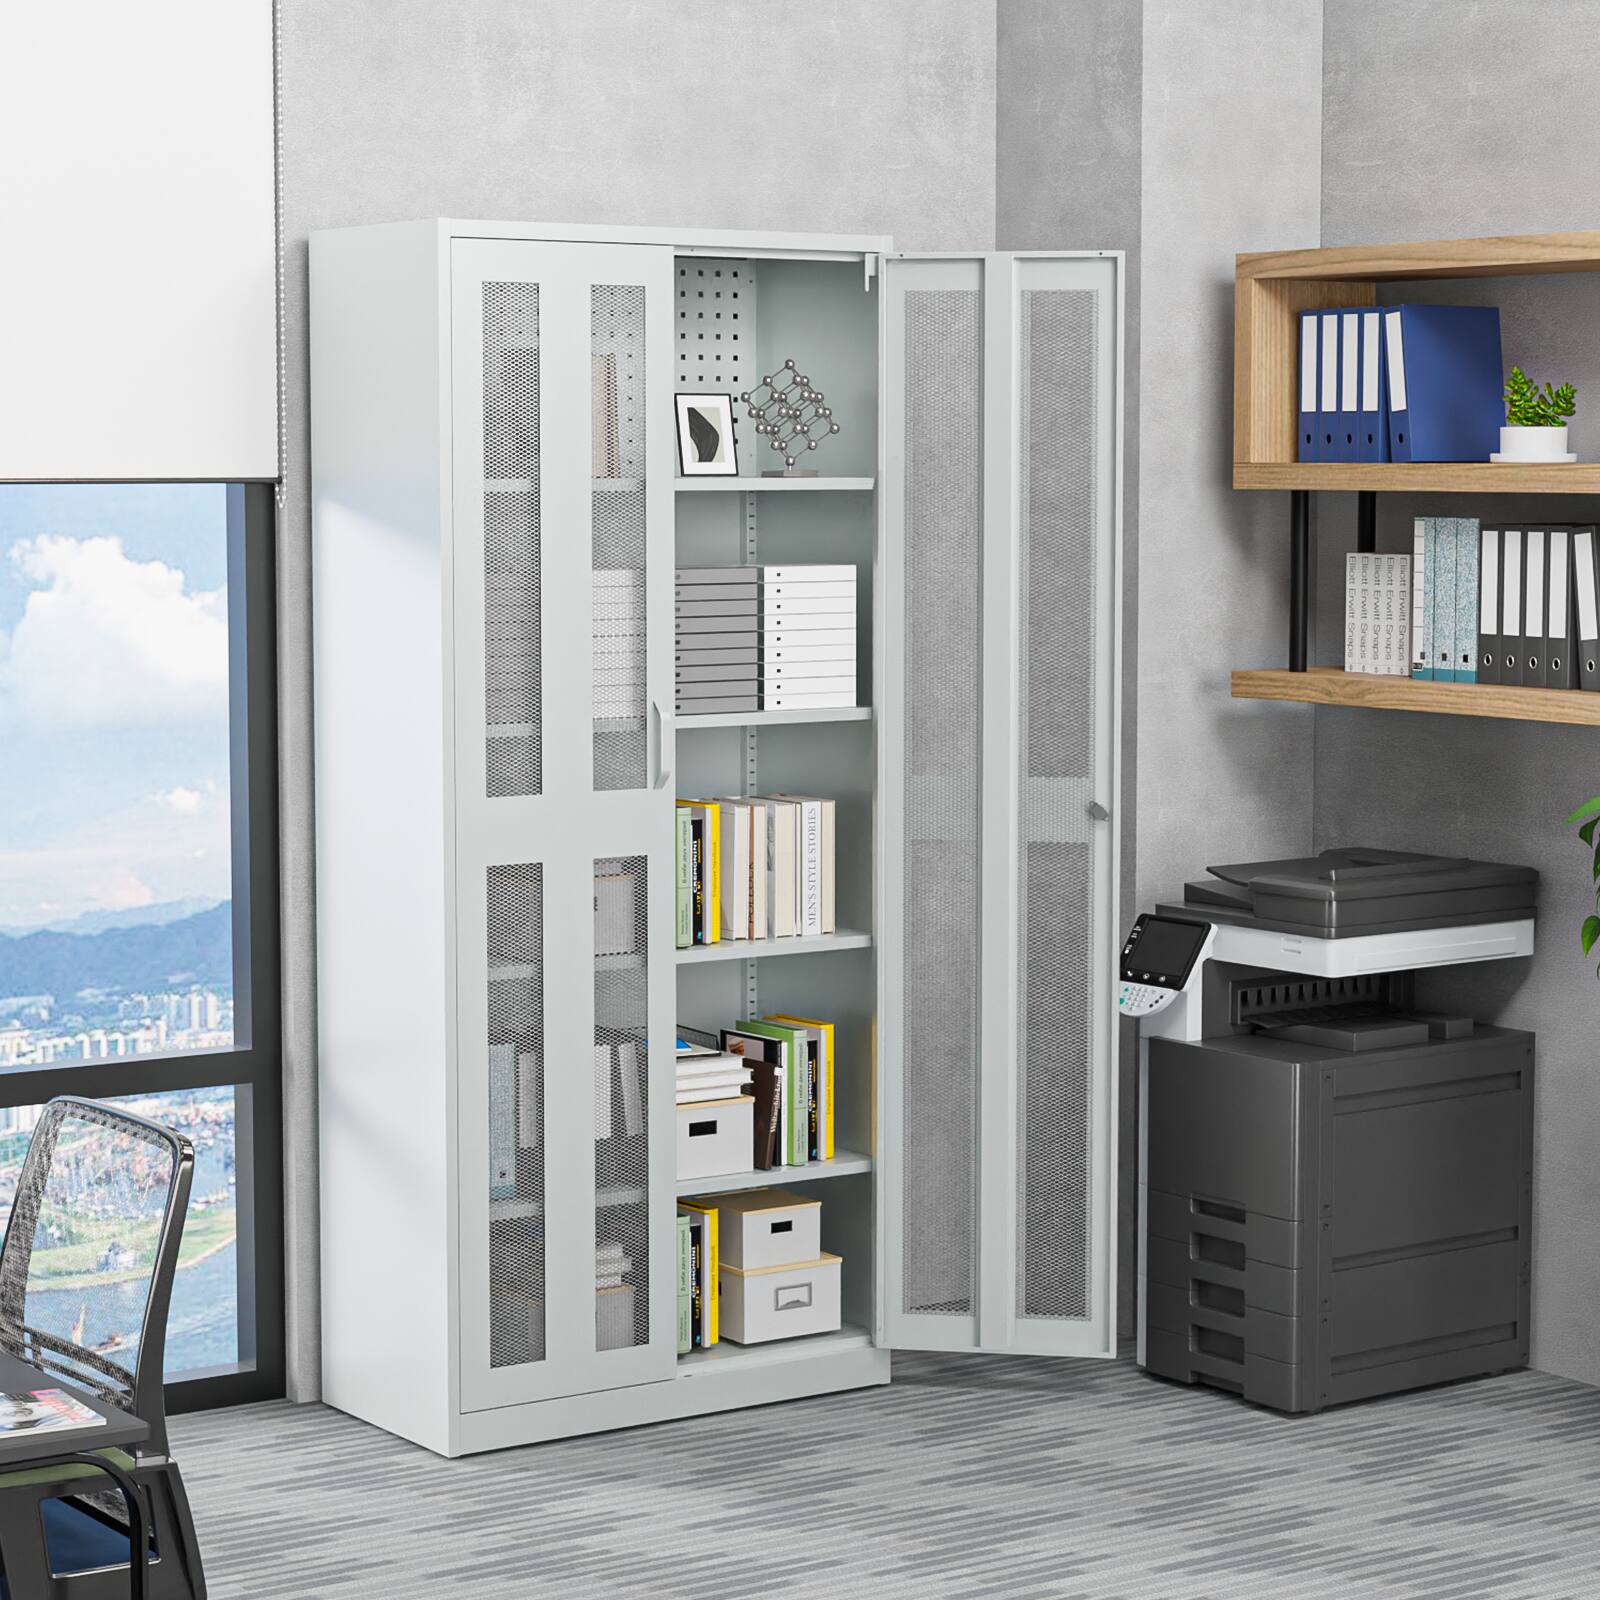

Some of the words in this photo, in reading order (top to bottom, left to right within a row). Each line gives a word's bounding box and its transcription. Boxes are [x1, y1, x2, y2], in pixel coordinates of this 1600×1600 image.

[1348, 556, 1356, 585] Elliott
[1361, 556, 1369, 585] Elliott
[1374, 557, 1382, 586] Elliott
[1386, 557, 1394, 586] Elliott
[1399, 557, 1407, 586] Elliott
[1348, 588, 1356, 618] Erwitt
[1361, 589, 1369, 619] Erwitt
[1374, 590, 1382, 621] Erwitt
[1386, 590, 1394, 621] Erwitt
[1399, 590, 1407, 621] Erwitt
[1347, 622, 1355, 658] Snaps
[1360, 623, 1368, 659] Snaps
[1372, 624, 1381, 660] Snaps
[1385, 624, 1393, 660] Snaps
[1397, 625, 1406, 661] Snaps
[808, 807, 817, 854] STORIES
[808, 855, 817, 891] STYLE
[808, 893, 817, 927] MEN'S
